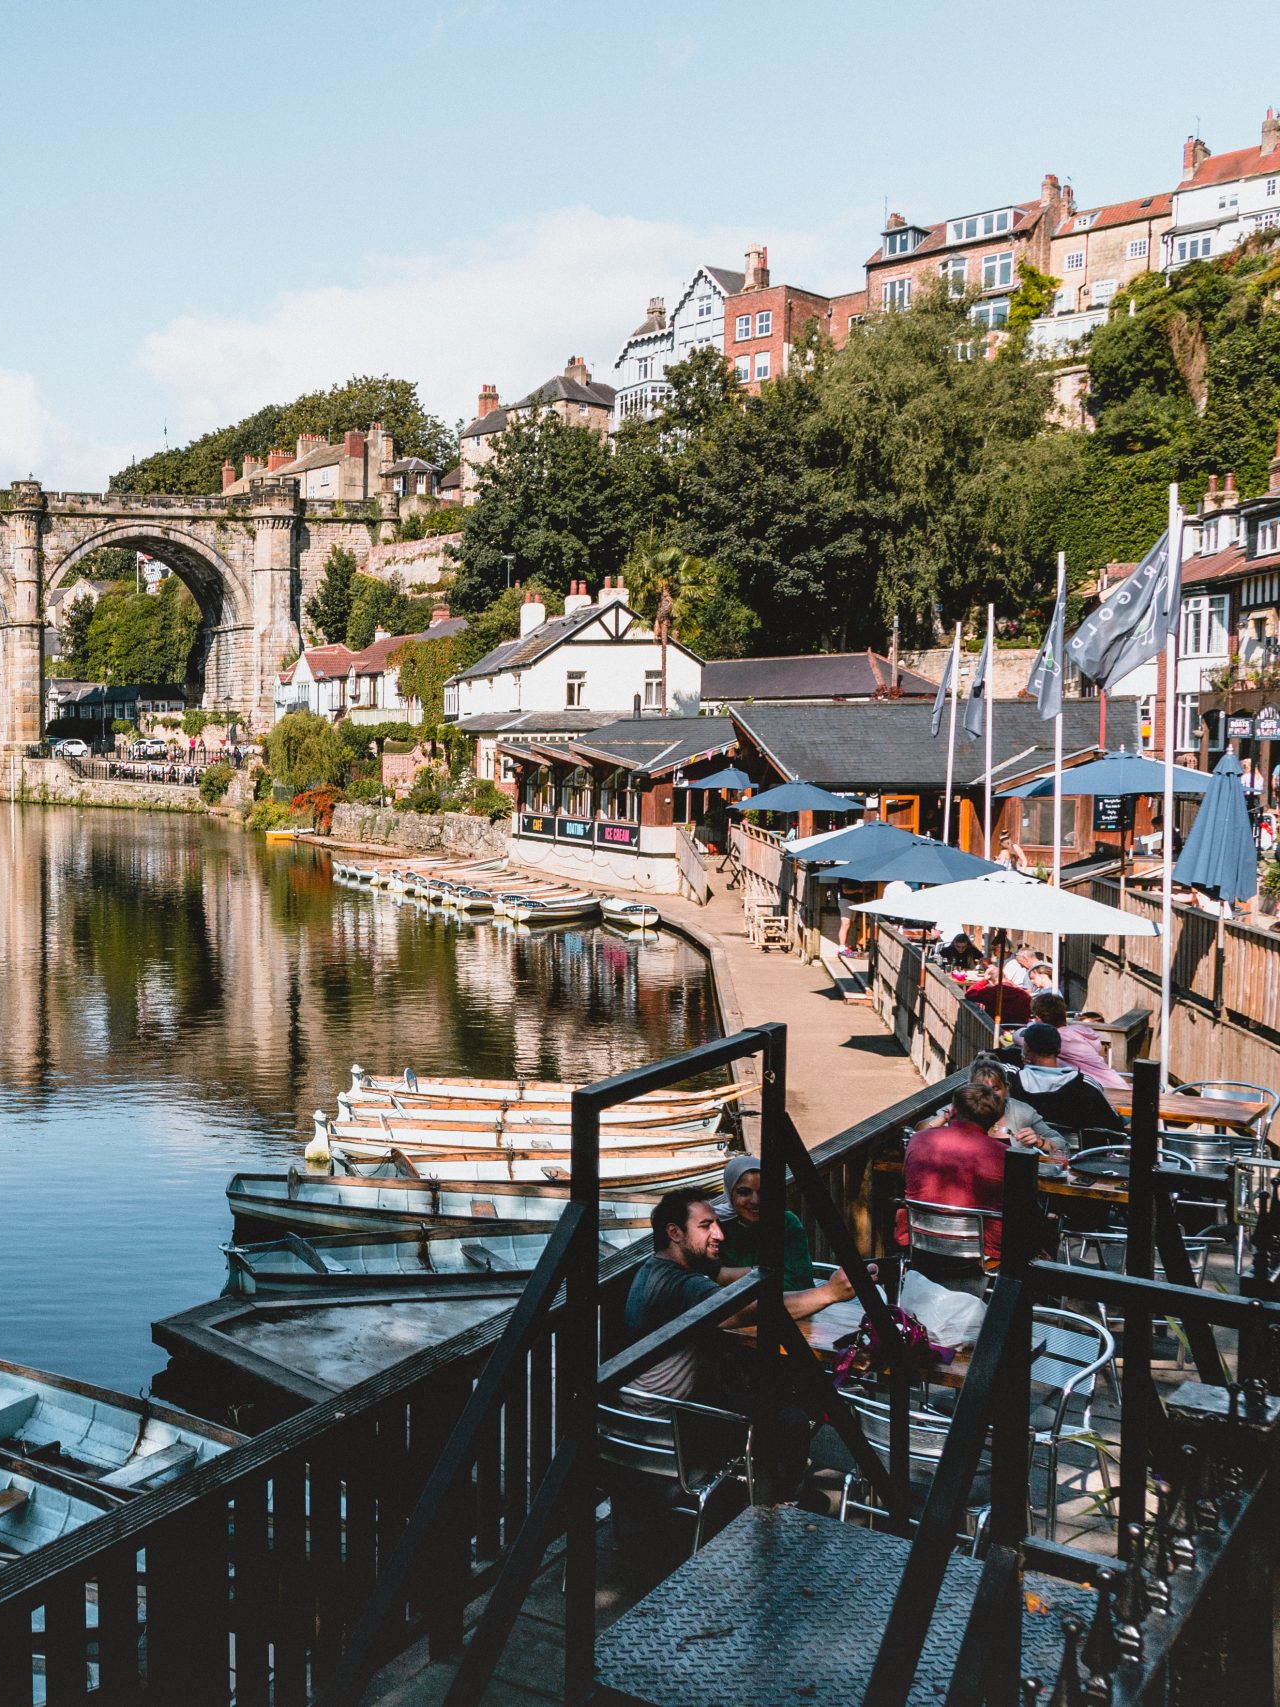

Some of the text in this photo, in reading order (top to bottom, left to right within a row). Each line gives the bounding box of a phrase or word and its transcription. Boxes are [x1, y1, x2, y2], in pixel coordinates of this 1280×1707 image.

[566, 822, 584, 836] BOATING
[604, 827, 630, 842] ICE CREAM
